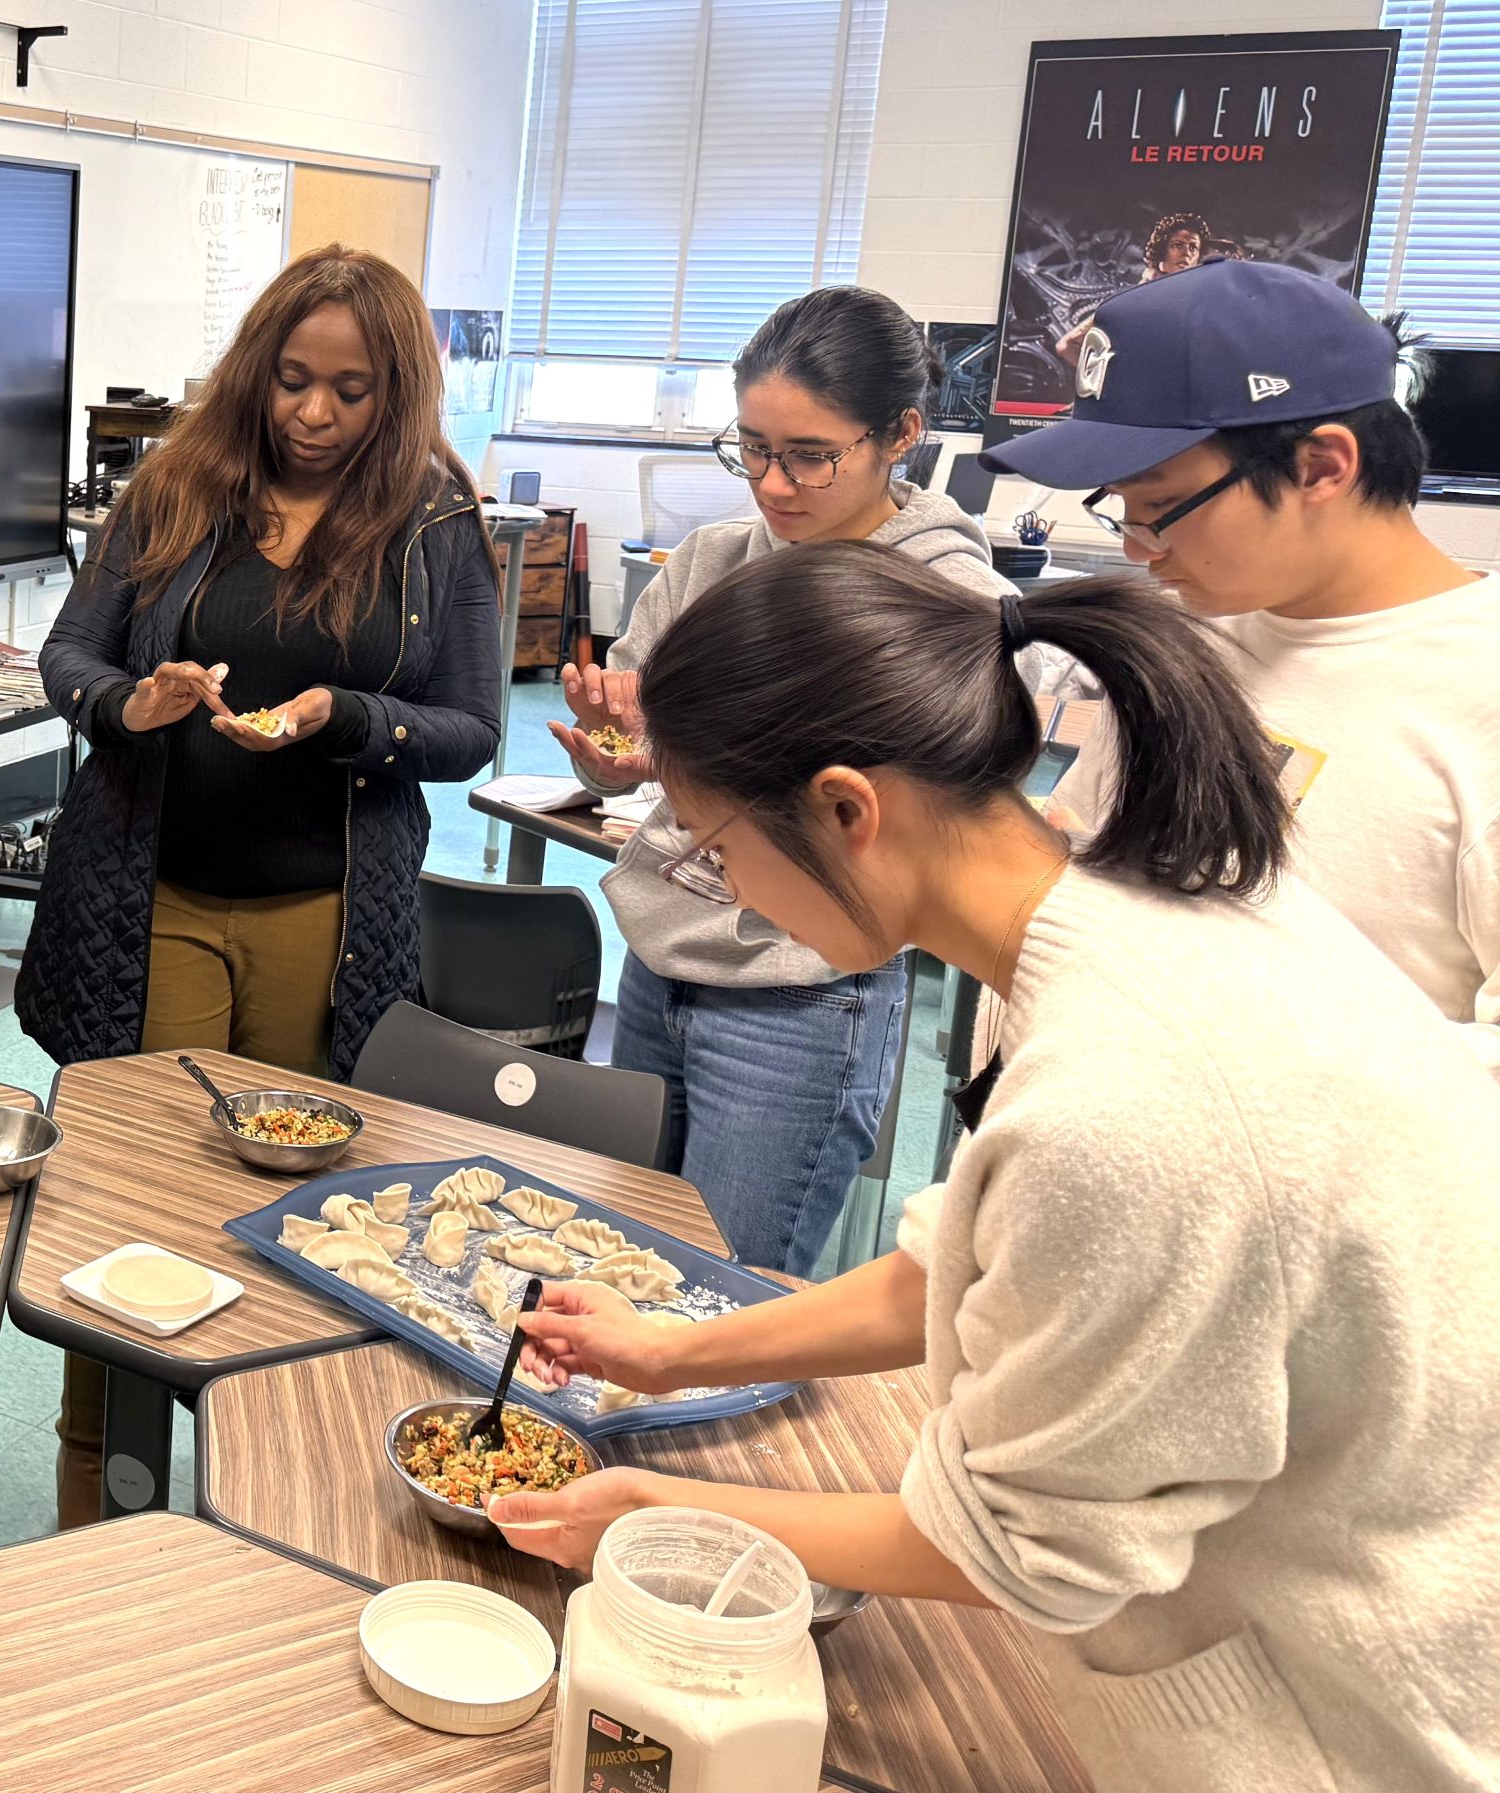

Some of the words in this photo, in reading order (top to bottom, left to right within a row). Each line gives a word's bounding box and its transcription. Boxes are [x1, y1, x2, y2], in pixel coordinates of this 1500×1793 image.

[1087, 86, 1317, 140] ALIENS
[1131, 145, 1159, 163] LE
[1167, 145, 1265, 163] RETOUR
